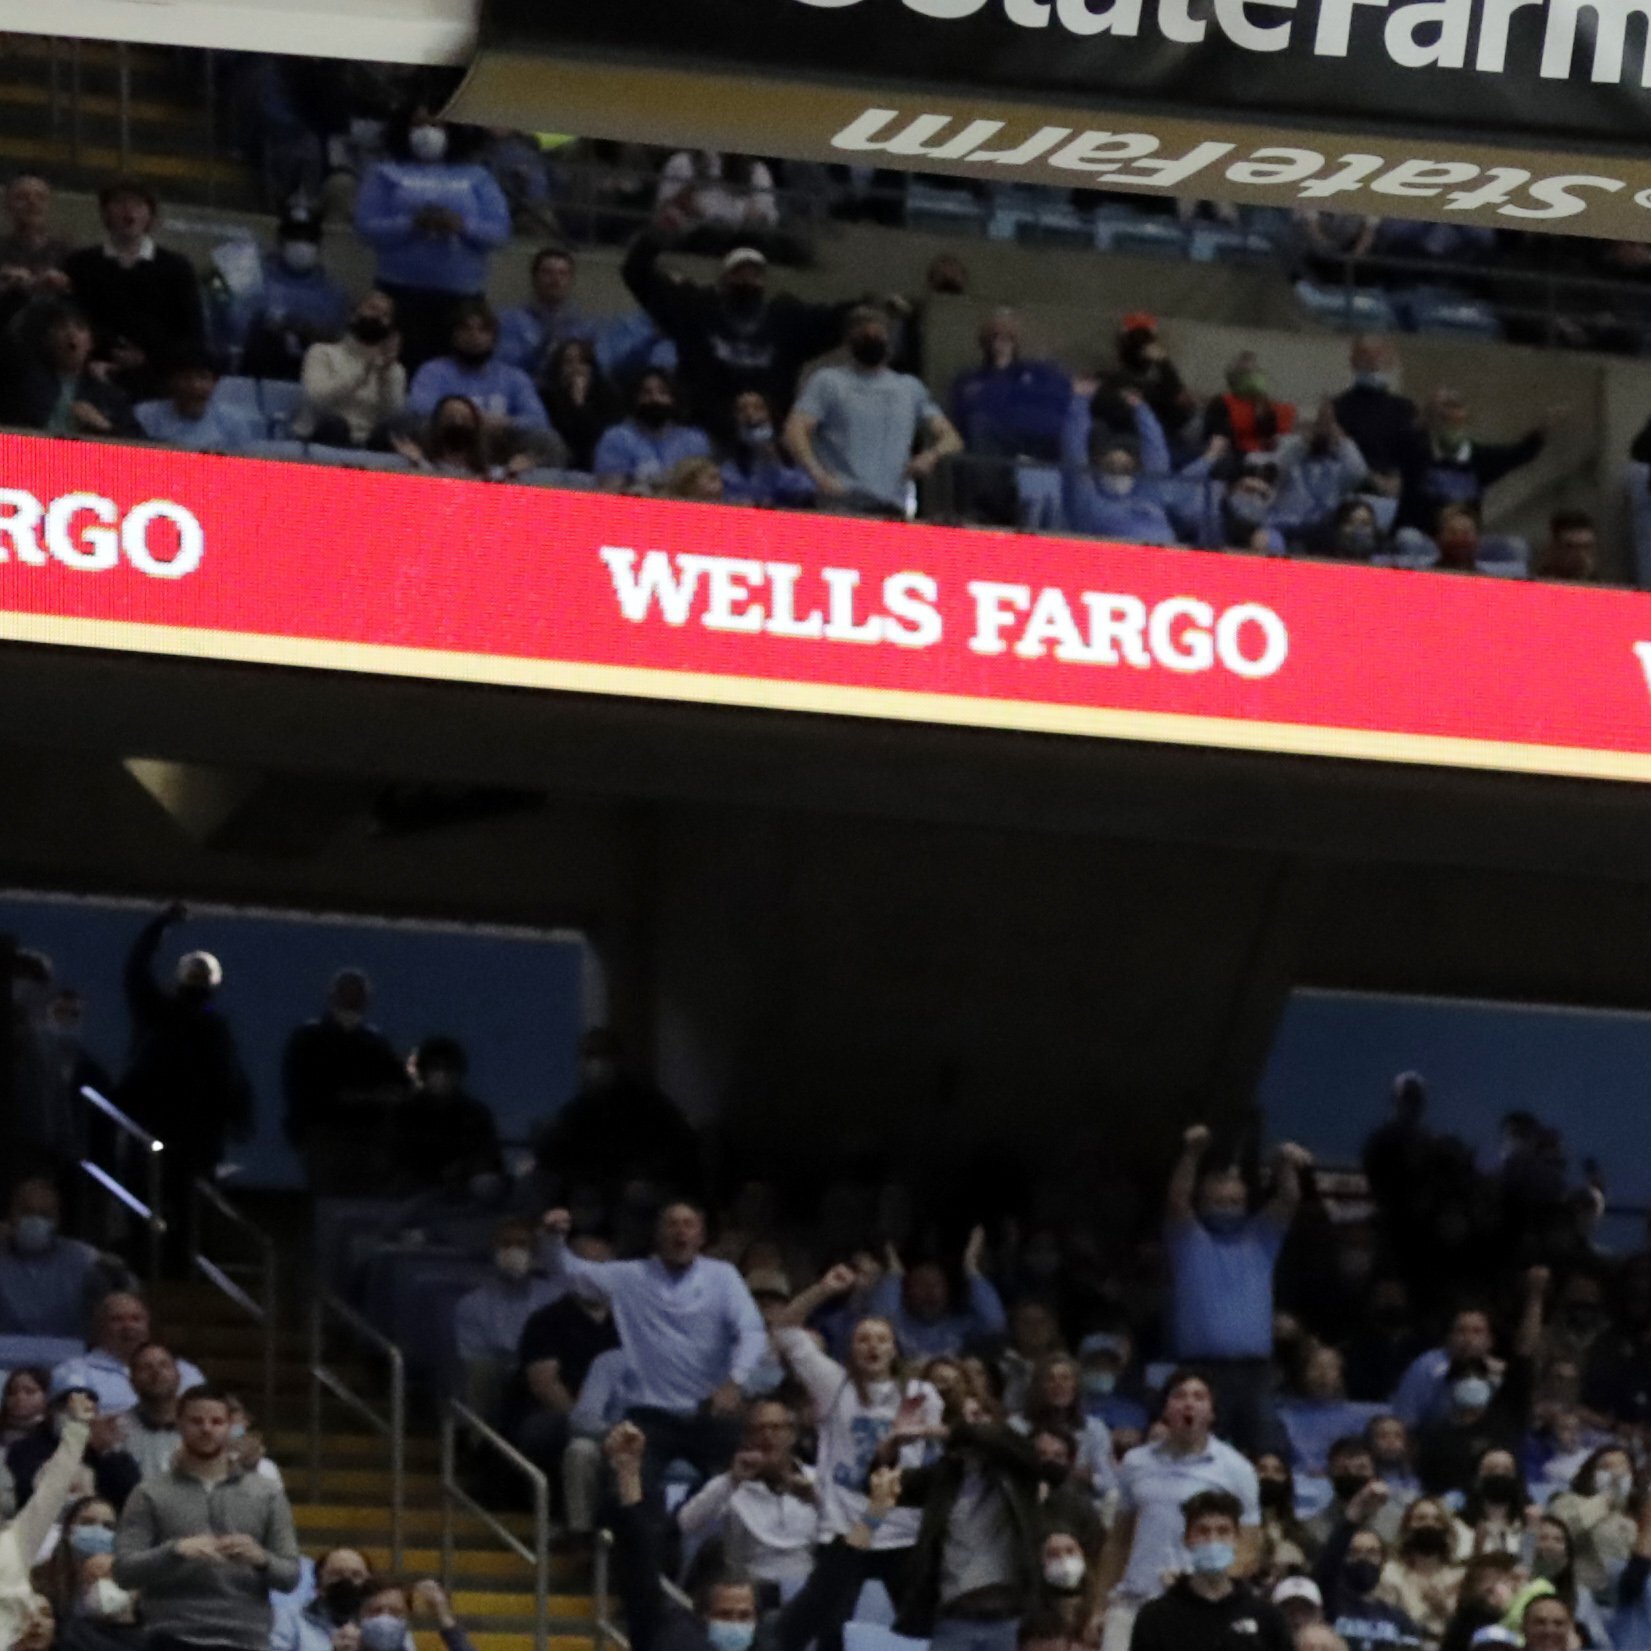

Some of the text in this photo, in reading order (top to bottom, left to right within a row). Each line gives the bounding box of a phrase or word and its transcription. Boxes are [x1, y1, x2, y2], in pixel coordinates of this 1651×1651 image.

[0, 487, 204, 579] RGO
[601, 546, 1288, 678] WELLS FARGO
